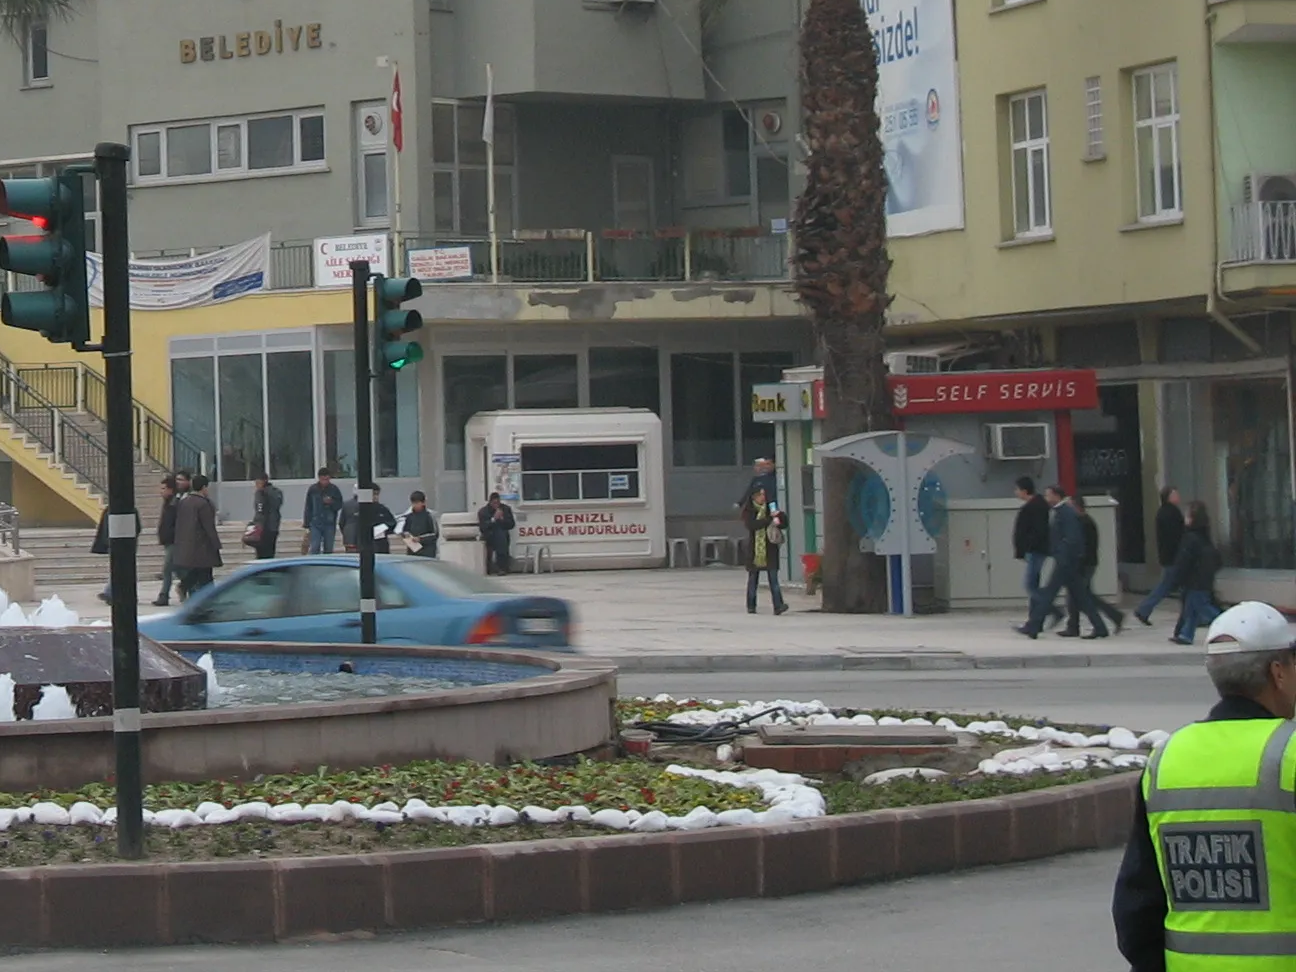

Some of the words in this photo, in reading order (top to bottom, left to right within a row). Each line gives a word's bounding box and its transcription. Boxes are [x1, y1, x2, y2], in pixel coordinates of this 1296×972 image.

[179, 19, 323, 64] BELEDİYE
[935, 384, 989, 402] SELF
[999, 379, 1077, 400] SERVİS
[553, 513, 614, 524] DENİZLİ
[1164, 834, 1254, 865] TRAFİK
[1170, 868, 1253, 899] POLİSİ
